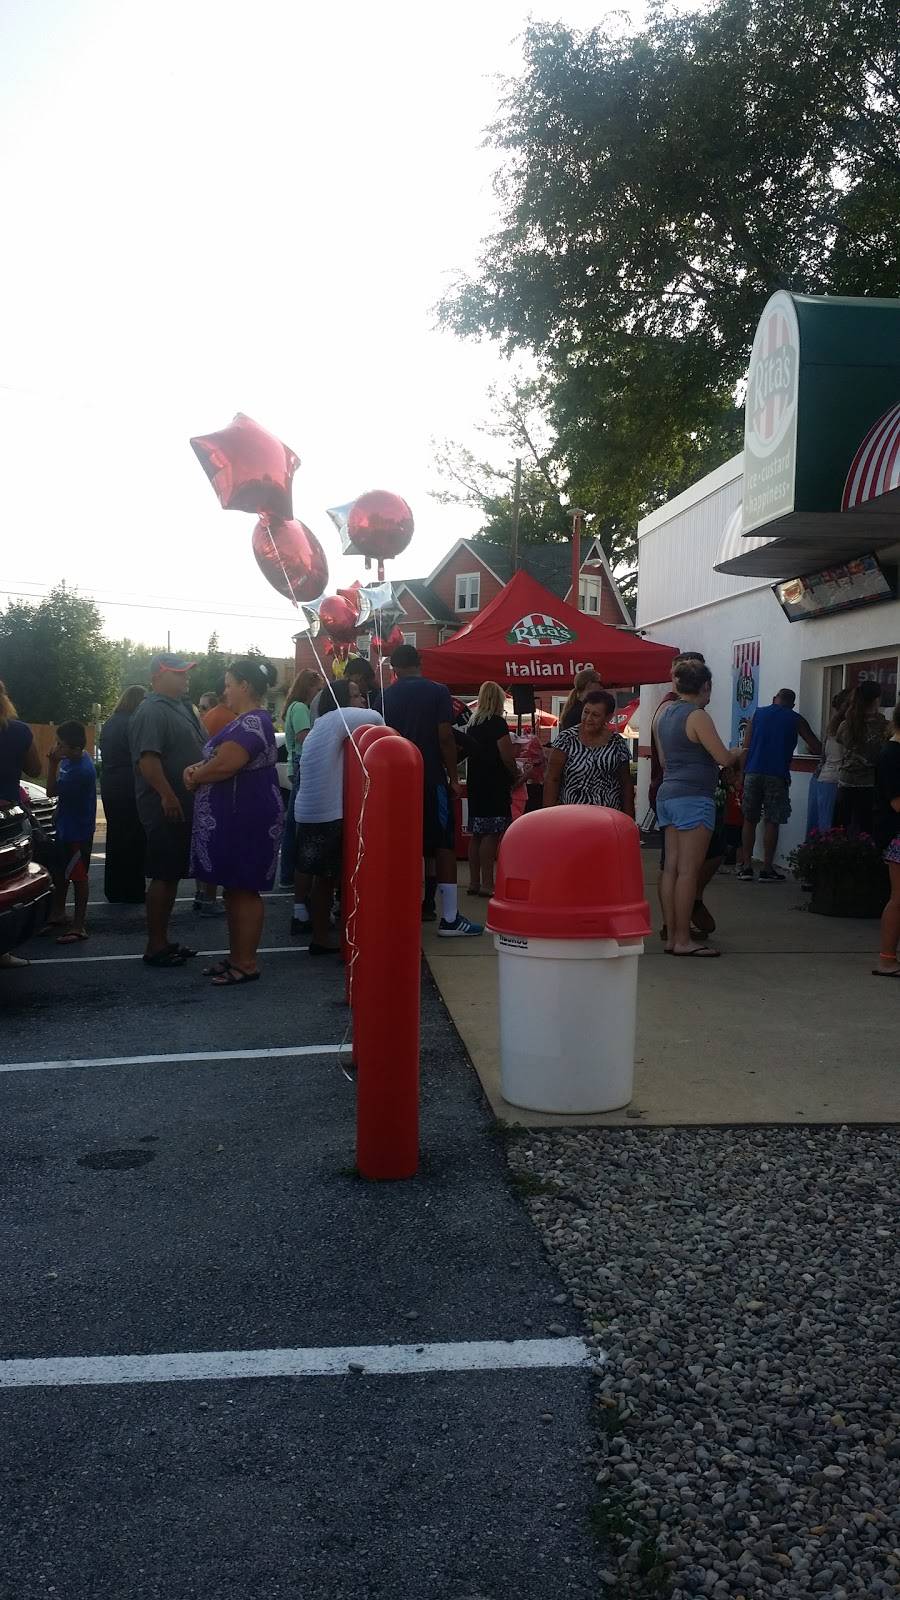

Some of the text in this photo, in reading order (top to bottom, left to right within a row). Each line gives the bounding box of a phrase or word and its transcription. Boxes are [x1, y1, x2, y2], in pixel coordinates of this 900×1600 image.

[754, 346, 791, 411] Rita's
[515, 625, 571, 641] Rita's
[505, 659, 594, 676] Italian Ice
